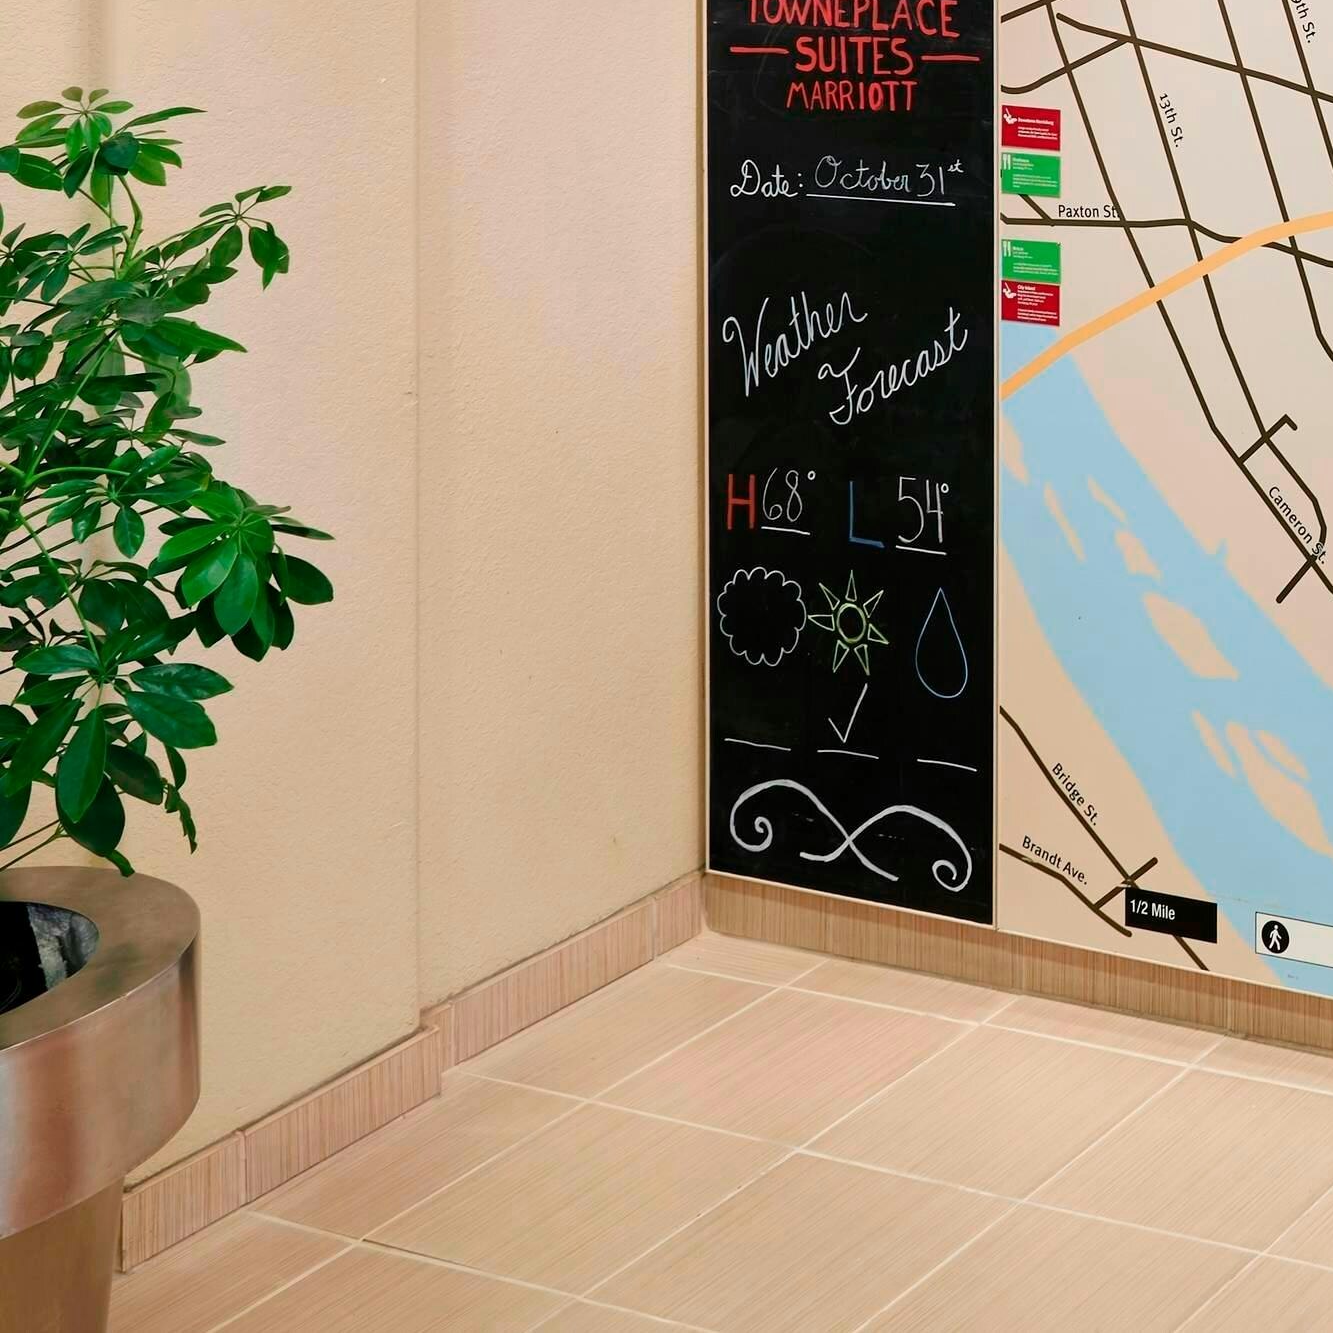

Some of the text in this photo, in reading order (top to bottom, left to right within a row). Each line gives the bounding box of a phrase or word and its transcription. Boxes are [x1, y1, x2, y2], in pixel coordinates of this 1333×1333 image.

[795, 37, 914, 76] SUITES
[1302, 21, 1317, 43] St.
[786, 80, 917, 111] MARRIOTT
[1159, 93, 1184, 147] 13th St.
[730, 159, 804, 199] Date:
[814, 155, 909, 192] October
[1058, 205, 1122, 219] Paxton St.
[722, 292, 867, 397] Weather
[818, 307, 968, 425] Forecast
[727, 474, 755, 530] H
[849, 480, 884, 547] L
[1268, 486, 1328, 566] Cameron St.
[1052, 763, 1099, 826] Bridge St.
[1022, 836, 1088, 886] Brandt Ave.
[1130, 899, 1176, 921] 1/2 Mile
